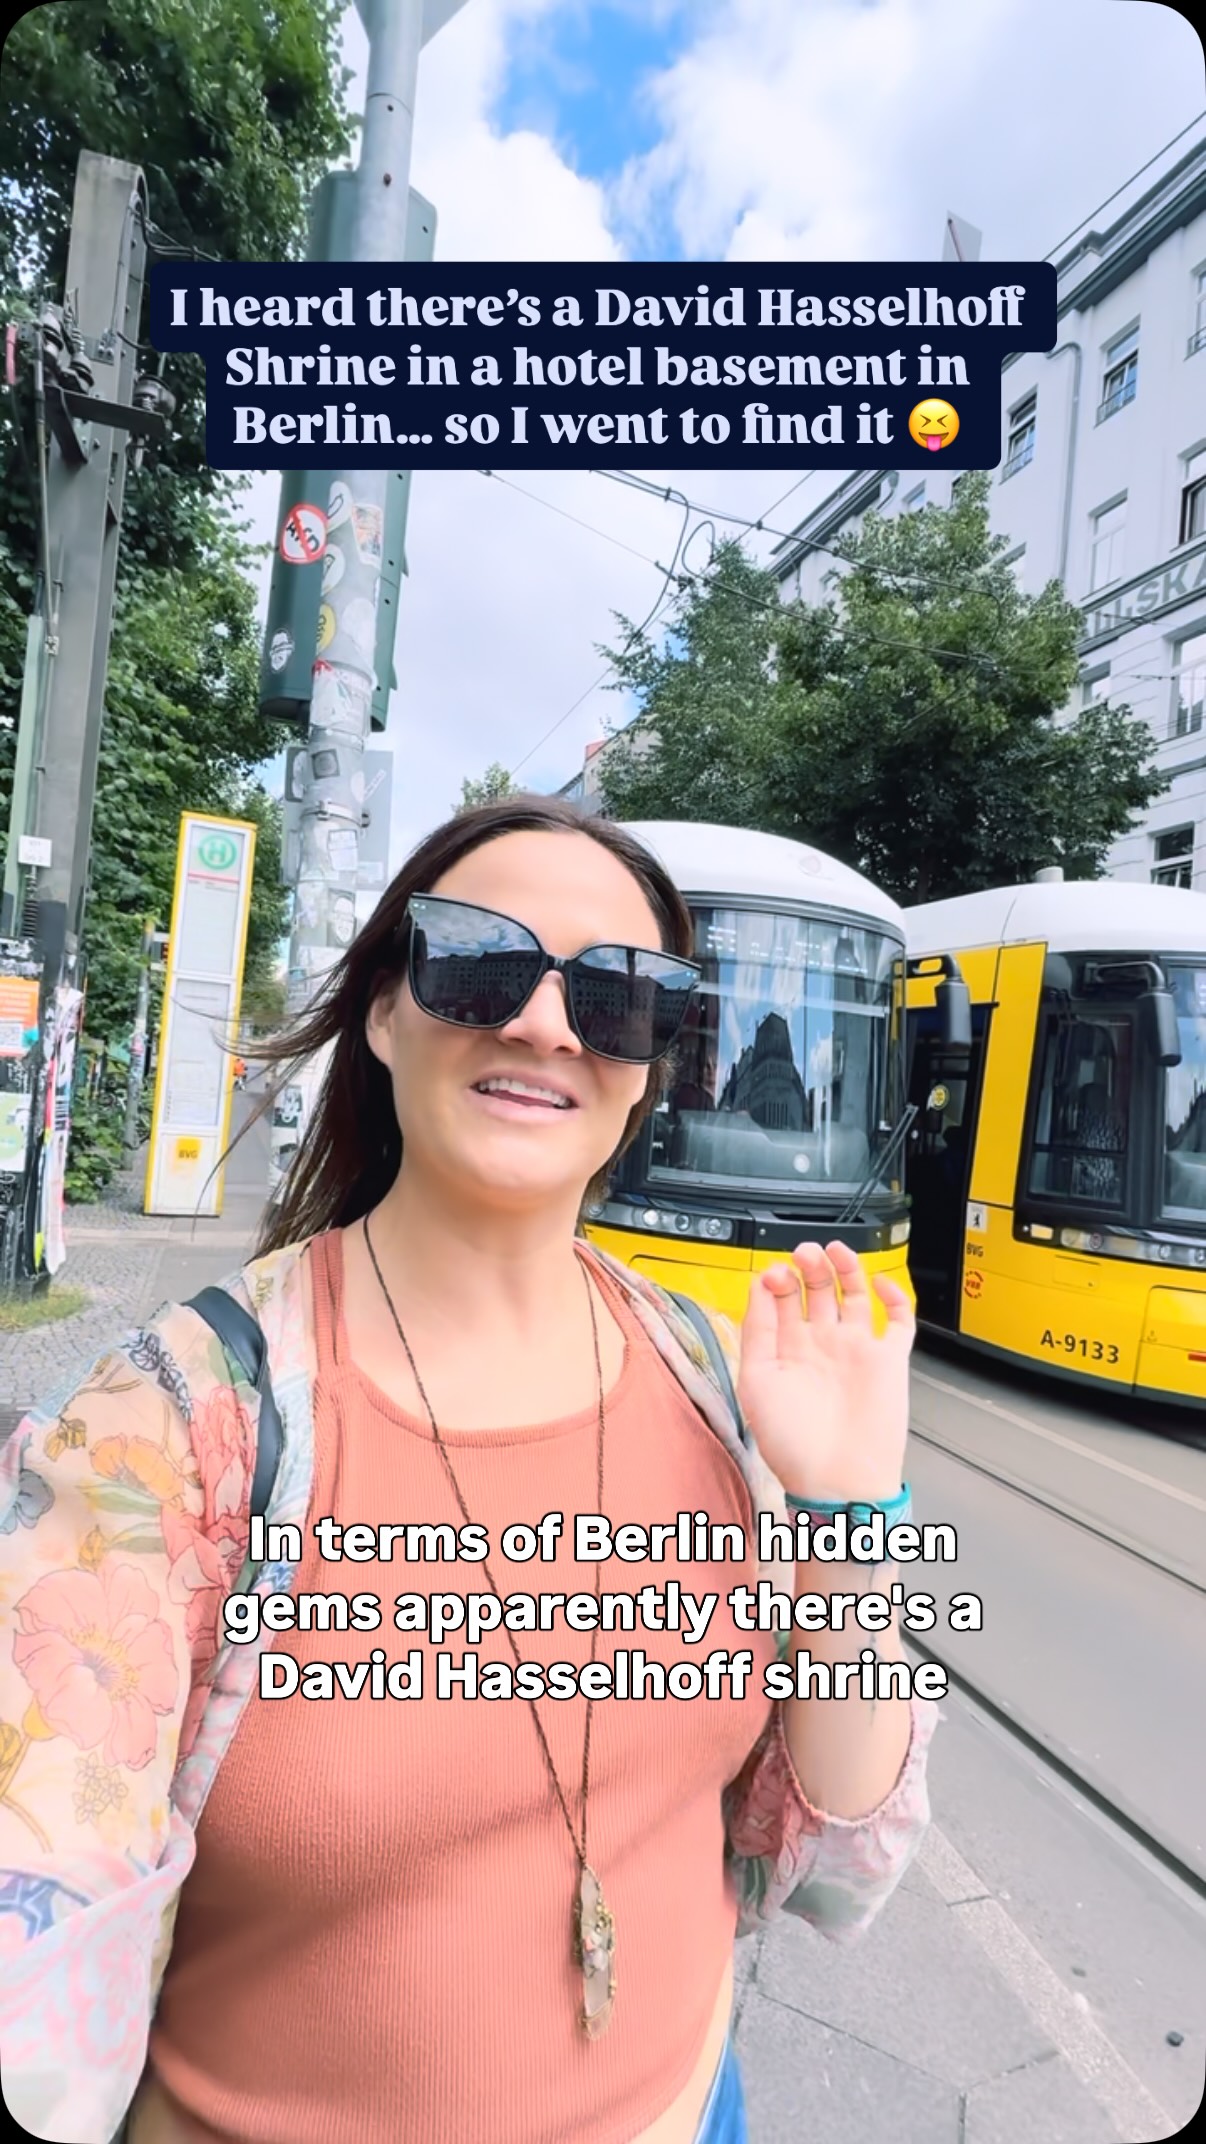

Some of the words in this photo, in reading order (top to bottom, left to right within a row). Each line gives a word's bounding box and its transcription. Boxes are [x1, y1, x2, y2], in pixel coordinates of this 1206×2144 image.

[178, 1149, 199, 1159] BVG
[966, 1242, 984, 1258] BVG
[1040, 1329, 1120, 1364] A-9133
